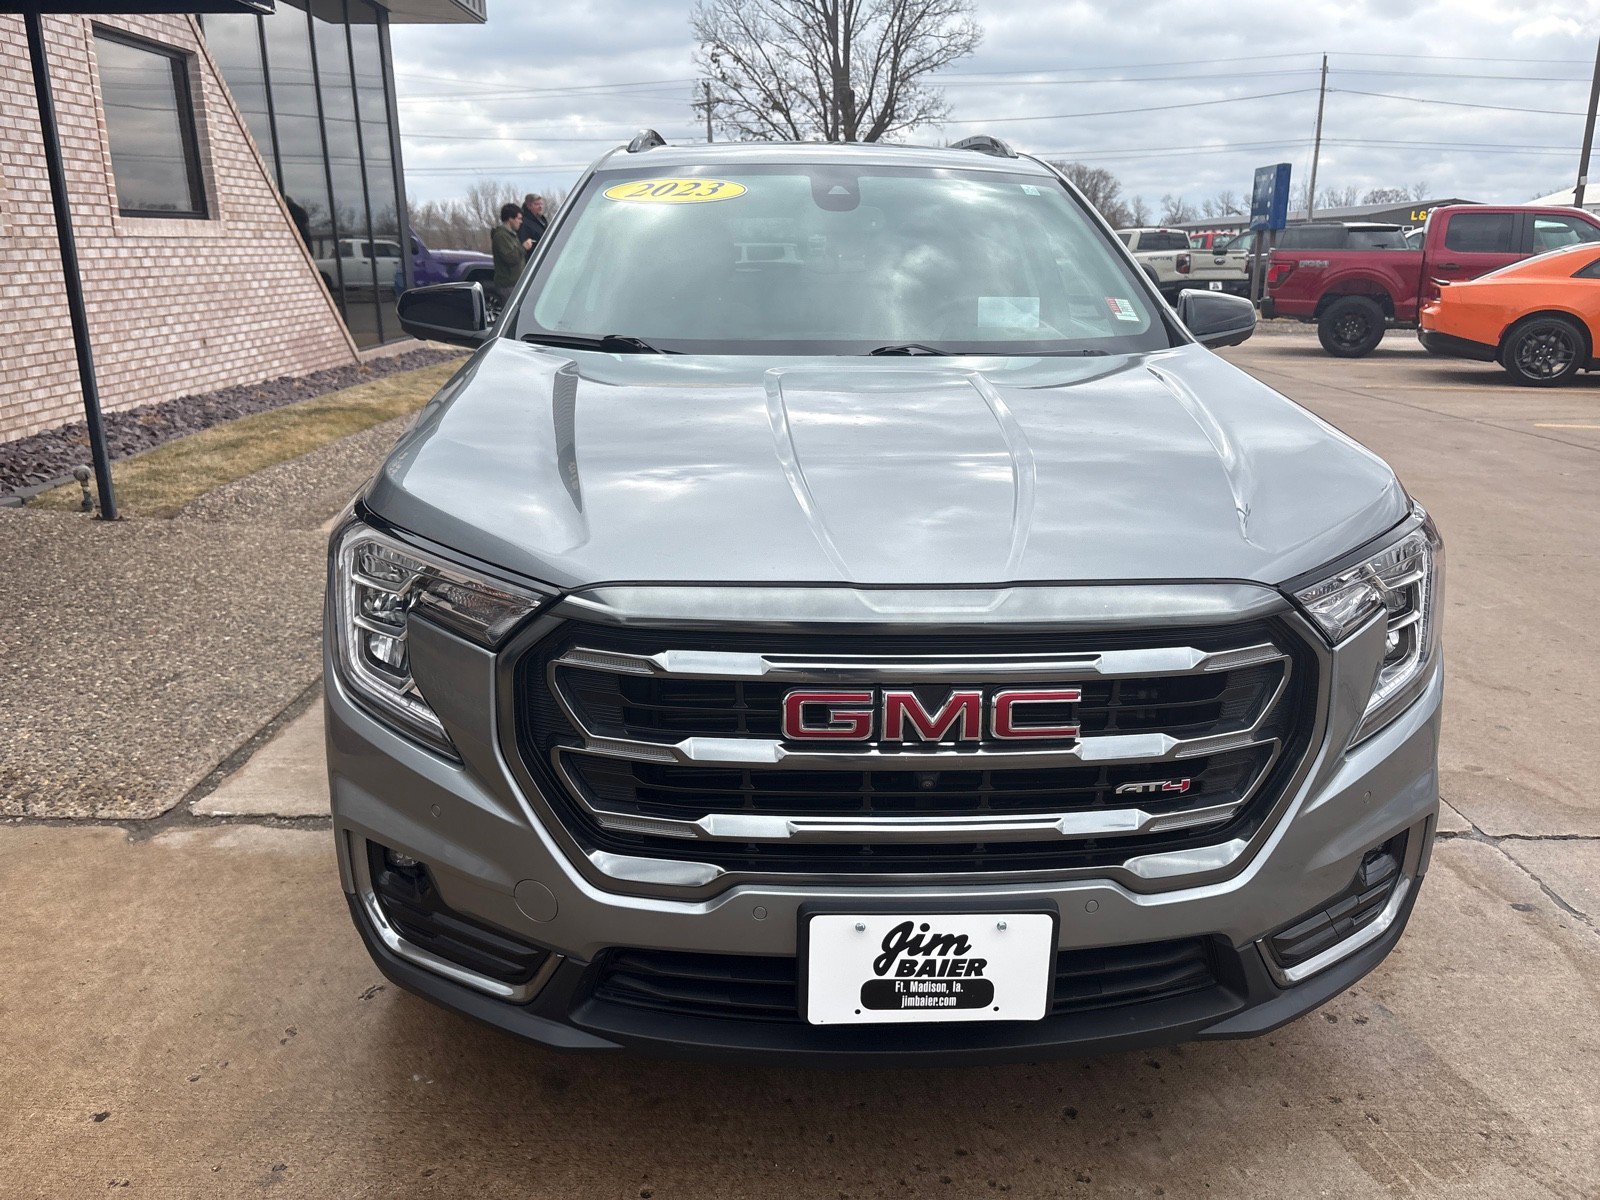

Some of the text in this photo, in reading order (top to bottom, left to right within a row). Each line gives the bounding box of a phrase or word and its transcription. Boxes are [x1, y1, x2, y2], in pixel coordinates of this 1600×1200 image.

[625, 182, 725, 197] 2023
[781, 688, 1082, 742] GMC
[1115, 778, 1191, 794] AT4
[873, 920, 972, 976] Jim
[894, 958, 988, 978] BAIER
[895, 981, 907, 993] Ft.
[909, 981, 950, 995] Madison,
[901, 995, 957, 1009] jimbaier.com
